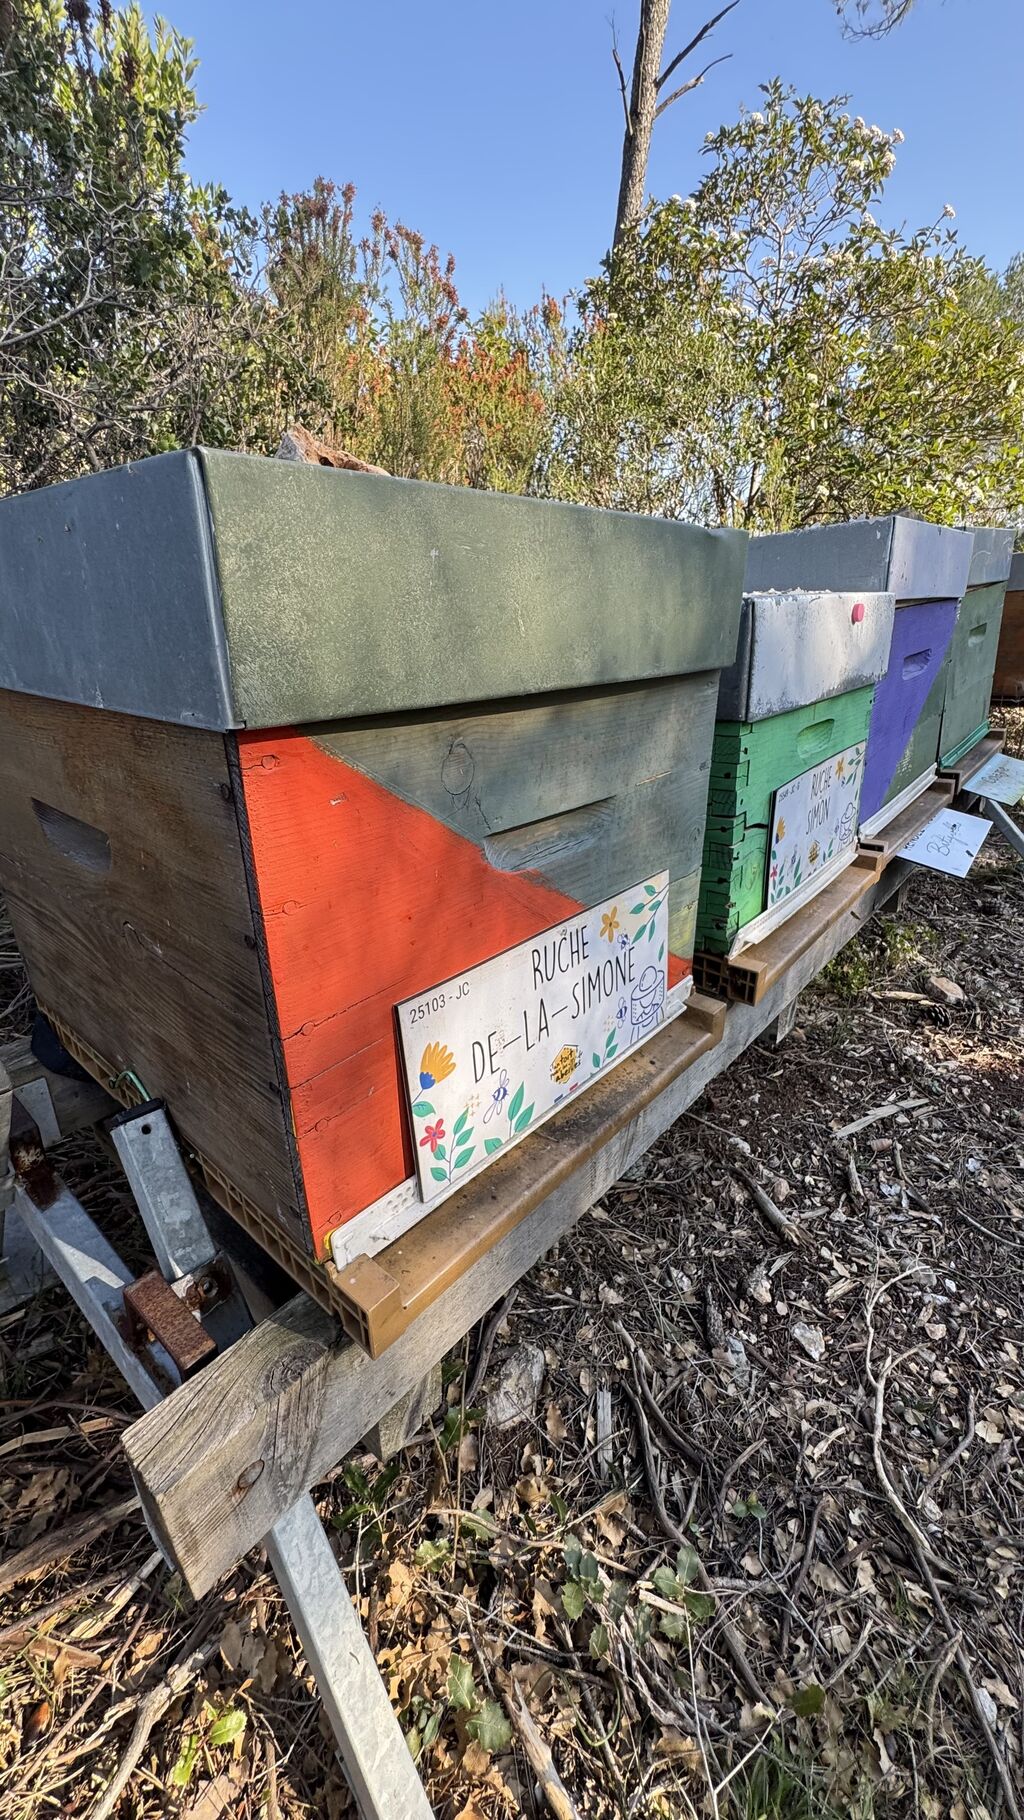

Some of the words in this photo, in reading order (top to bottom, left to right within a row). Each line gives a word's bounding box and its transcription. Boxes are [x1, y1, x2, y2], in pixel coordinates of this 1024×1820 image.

[810, 765, 833, 801] RUCHE
[531, 925, 590, 991] RUCHE
[409, 993, 446, 1025] 25103
[455, 981, 470, 1000] JC
